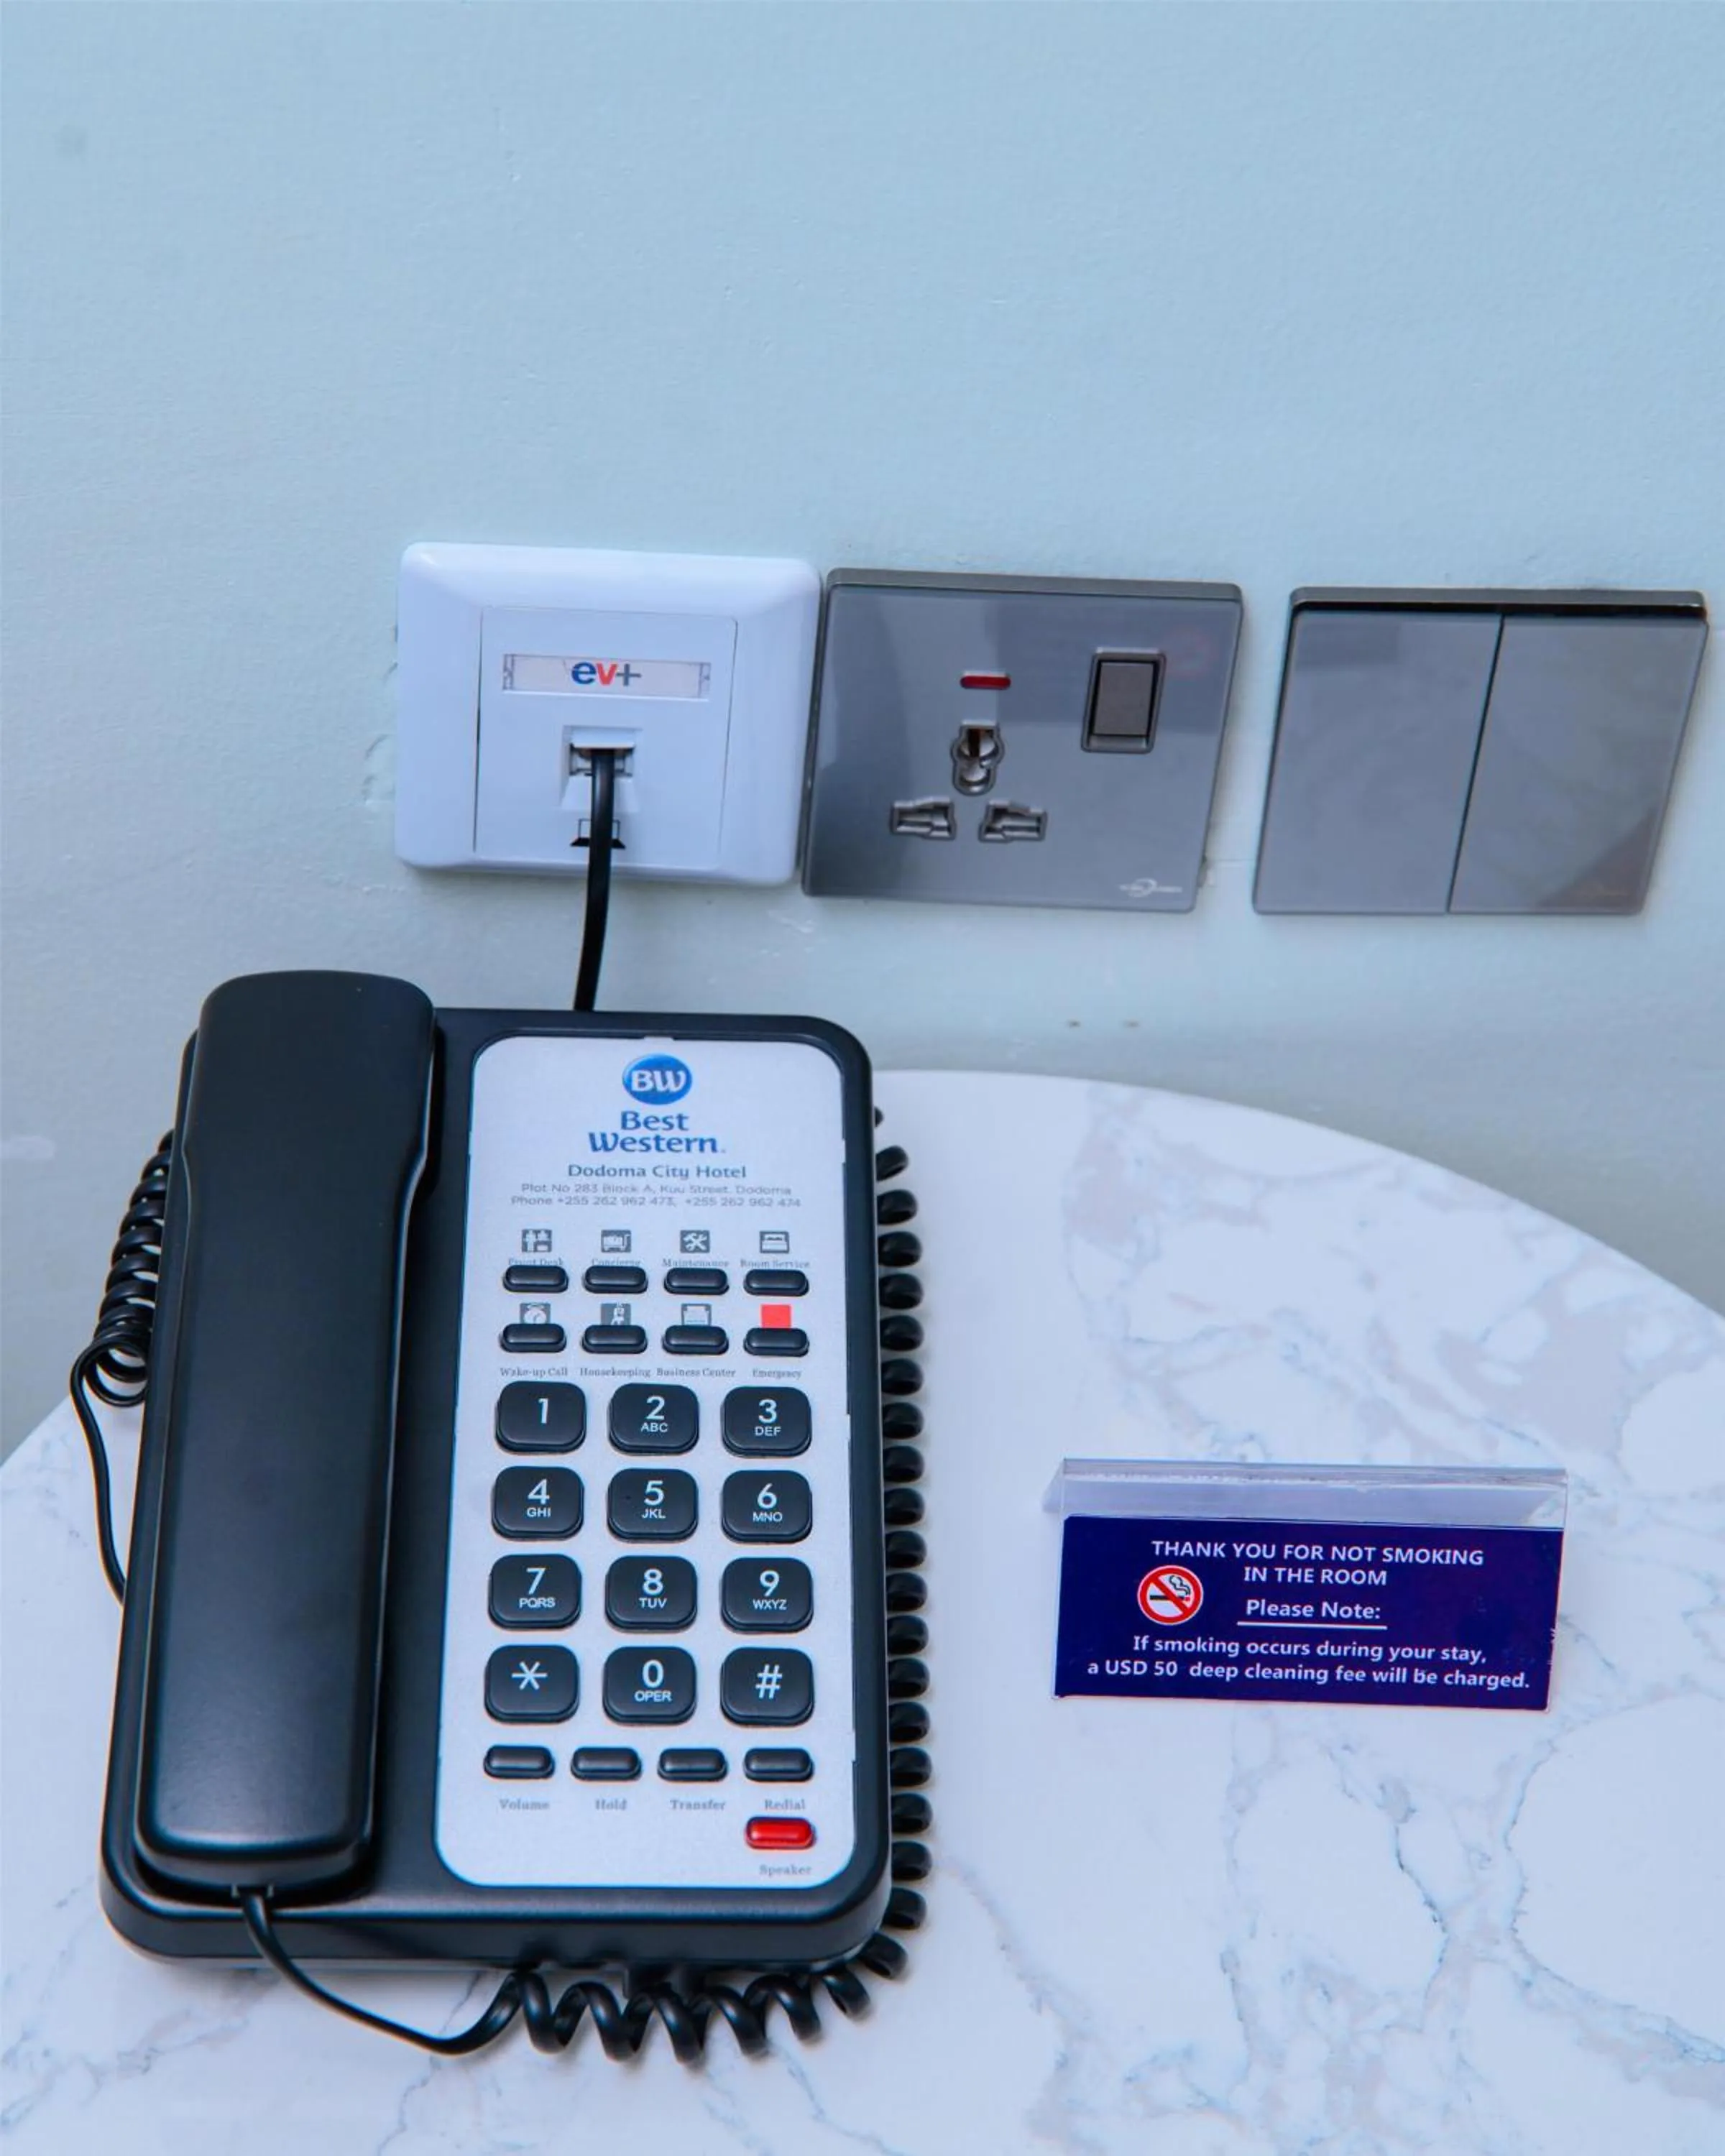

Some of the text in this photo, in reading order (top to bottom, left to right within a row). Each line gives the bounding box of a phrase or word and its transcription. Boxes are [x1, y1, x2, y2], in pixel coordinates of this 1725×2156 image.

[630, 1069, 687, 1093] BW
[620, 1110, 689, 1130] Best
[568, 1164, 746, 1180] Dodoma City Hotel
[521, 1183, 548, 1193] Plot
[552, 1184, 571, 1193] No
[574, 1184, 598, 1193] 283
[736, 1185, 791, 1196] Dodoma
[511, 1196, 553, 1205] Phone
[740, 1259, 809, 1268] Room Service
[500, 1368, 568, 1378] Wake-up Call
[579, 1368, 650, 1378] Housekeeping
[703, 1368, 736, 1377] Center
[753, 1370, 802, 1379] Emergency
[538, 1398, 549, 1424] 1
[646, 1396, 665, 1420] 2
[758, 1399, 777, 1424] 3
[640, 1422, 668, 1433] ABC
[755, 1426, 781, 1437] DEF
[528, 1478, 551, 1505] 4
[645, 1480, 665, 1506] 5
[757, 1483, 777, 1509] 6
[526, 1507, 551, 1518] GHI
[641, 1508, 666, 1519] JKL
[753, 1511, 783, 1523] MNO
[1151, 1540, 1484, 1565] THANK YOU FOR NOT SMOKING
[526, 1567, 546, 1594] 7
[643, 1568, 663, 1595] 8
[1244, 1566, 1387, 1585] IN THE ROOM
[760, 1570, 780, 1597] 9
[519, 1597, 556, 1609] PQRS
[639, 1598, 668, 1609] TUV
[753, 1599, 788, 1611] WXYZ
[1246, 1599, 1381, 1619] Please Note:
[1133, 1635, 1487, 1665] If smoking occurs during your stay,
[642, 1659, 664, 1688] 0
[1087, 1659, 1530, 1690] a USD 50 deep cleaning fee will be charged.
[755, 1664, 783, 1699] #
[634, 1690, 672, 1703] OPER
[499, 1800, 549, 1810] Volume
[595, 1799, 627, 1810] Hold
[670, 1799, 727, 1810] Transfer
[764, 1799, 806, 1810] Redial
[759, 1864, 811, 1876] Speaker
